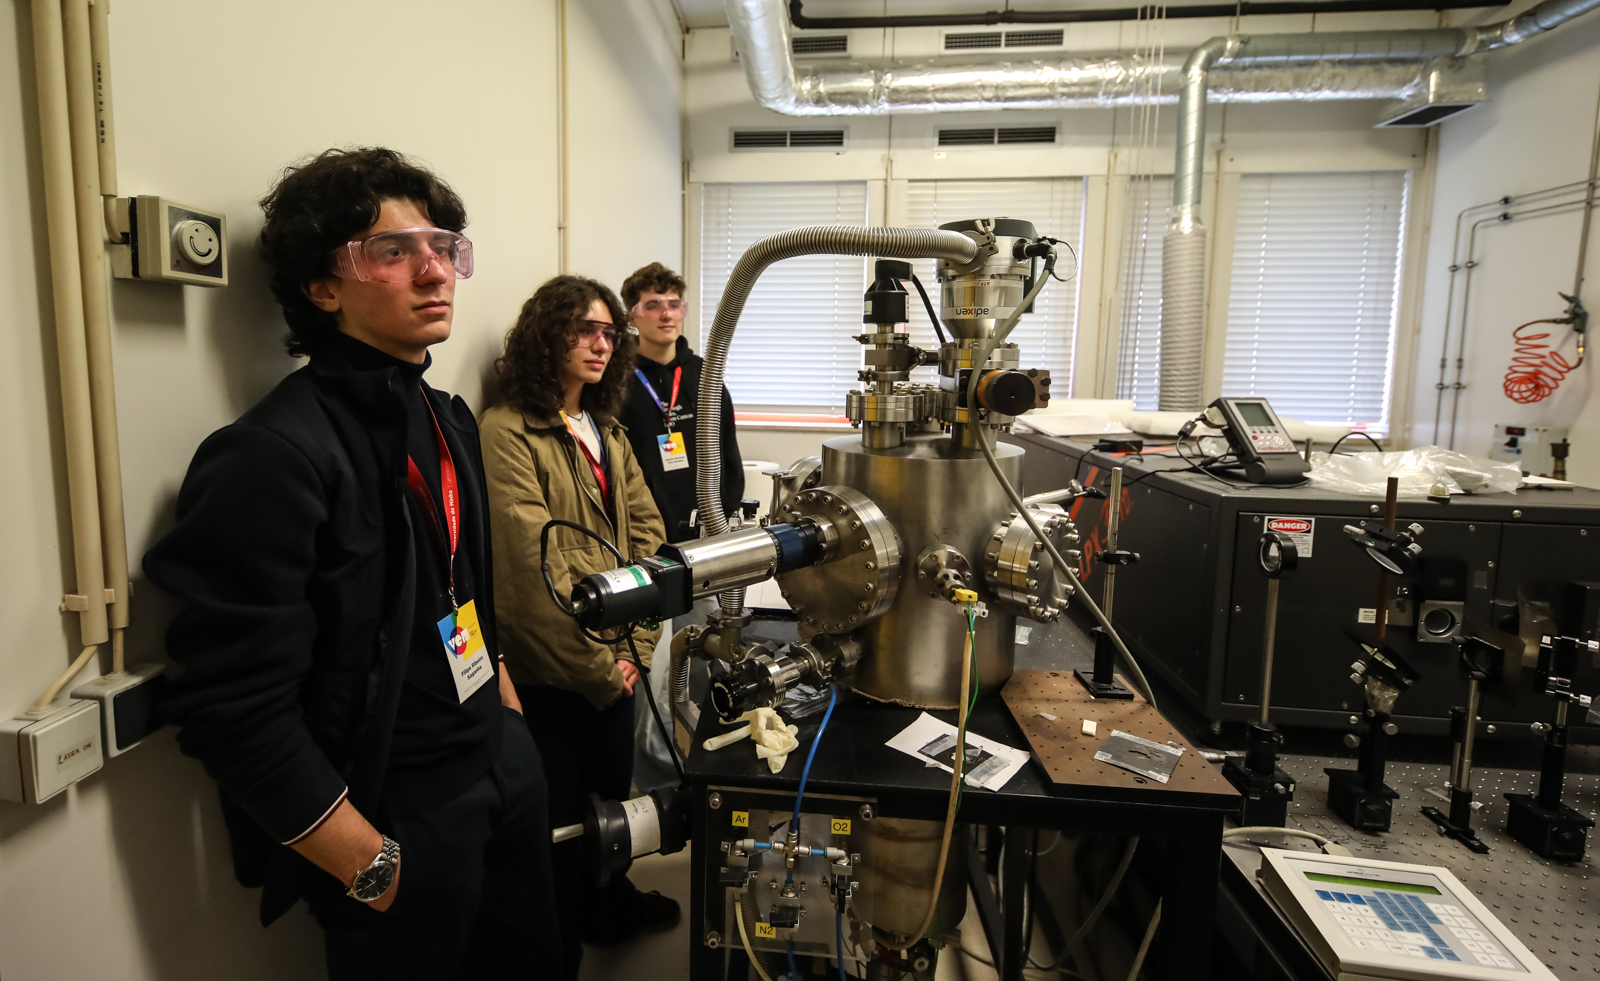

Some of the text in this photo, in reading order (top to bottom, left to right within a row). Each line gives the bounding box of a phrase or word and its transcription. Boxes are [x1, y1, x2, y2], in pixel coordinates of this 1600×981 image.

[956, 307, 990, 318] adixen
[1271, 522, 1308, 530] DANGER
[58, 742, 92, 764] LASER ON
[735, 815, 746, 824] Ar
[832, 822, 848, 832] O2
[760, 926, 774, 936] N2
